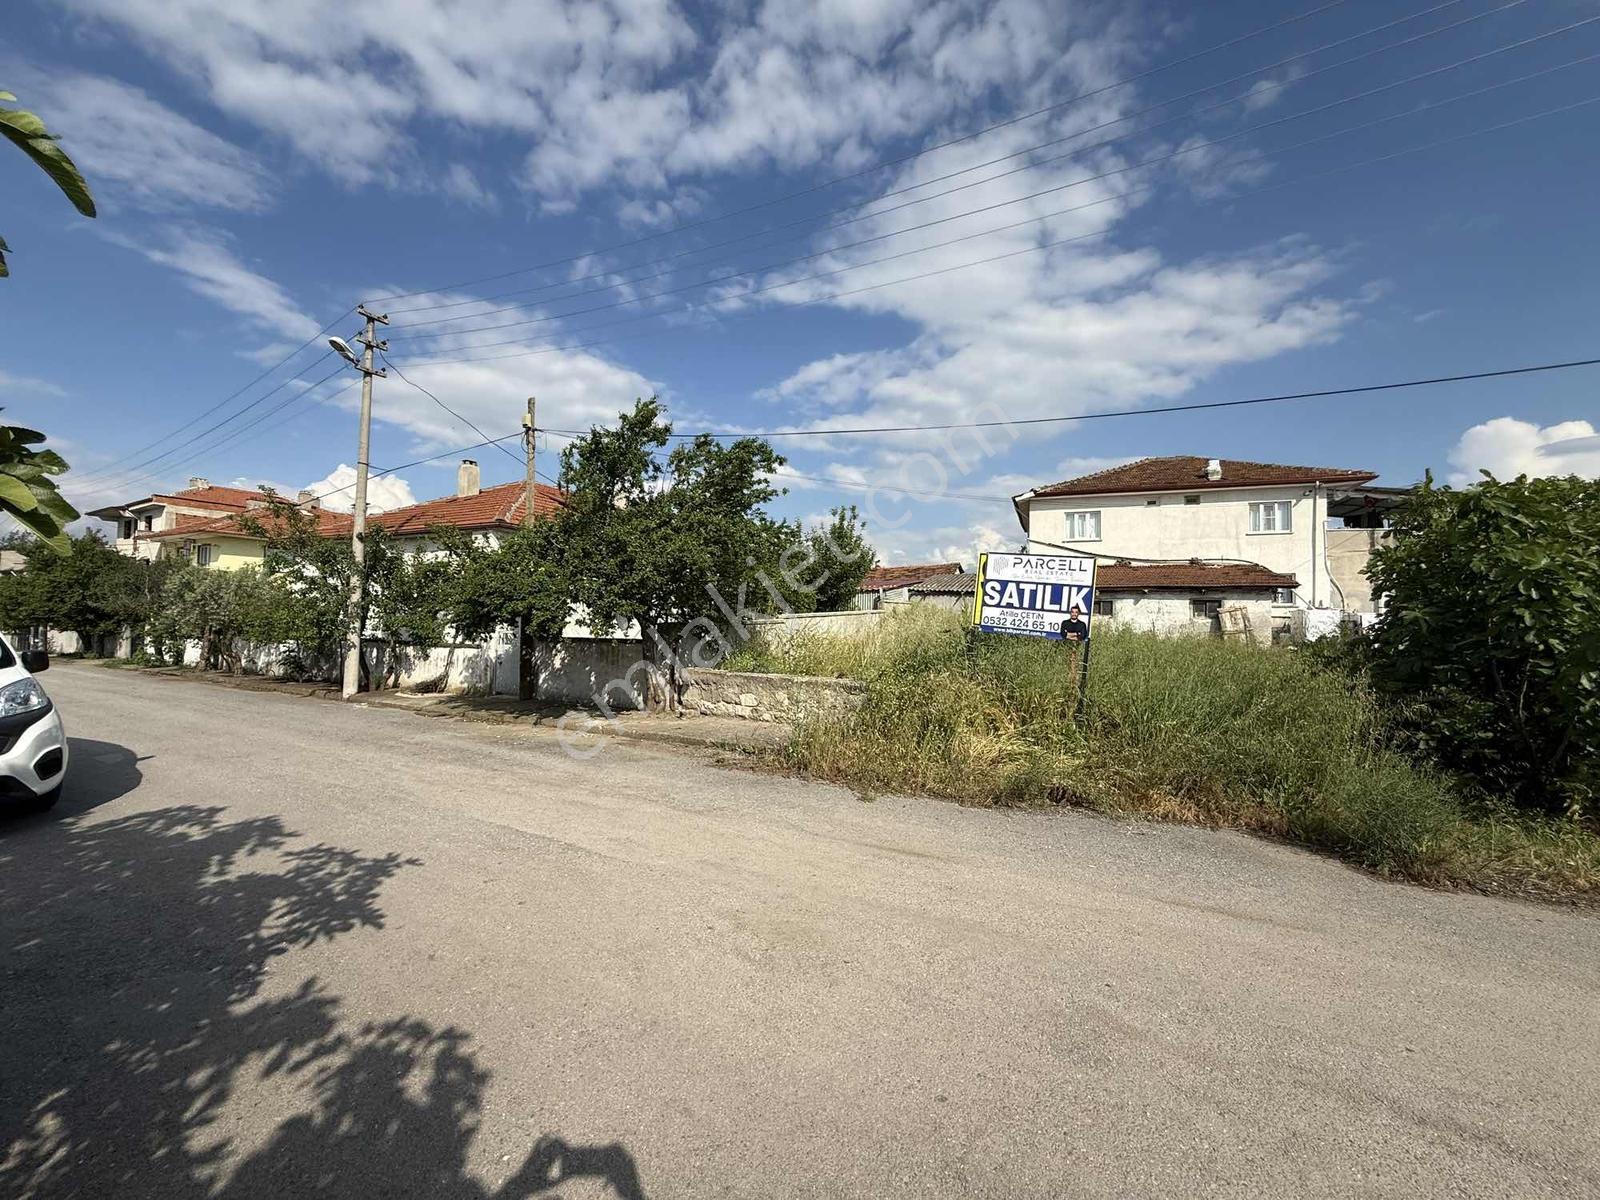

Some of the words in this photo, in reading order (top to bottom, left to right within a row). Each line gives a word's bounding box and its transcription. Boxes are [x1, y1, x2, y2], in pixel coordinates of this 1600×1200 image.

[1013, 557, 1087, 572] PARCELL
[983, 581, 1090, 613] SATILIK
[1000, 610, 1019, 618] Atilla
[983, 616, 1007, 626] 0532
[1010, 618, 1029, 628] 424
[1032, 620, 1045, 630] 65
[1048, 622, 1060, 631] 10
